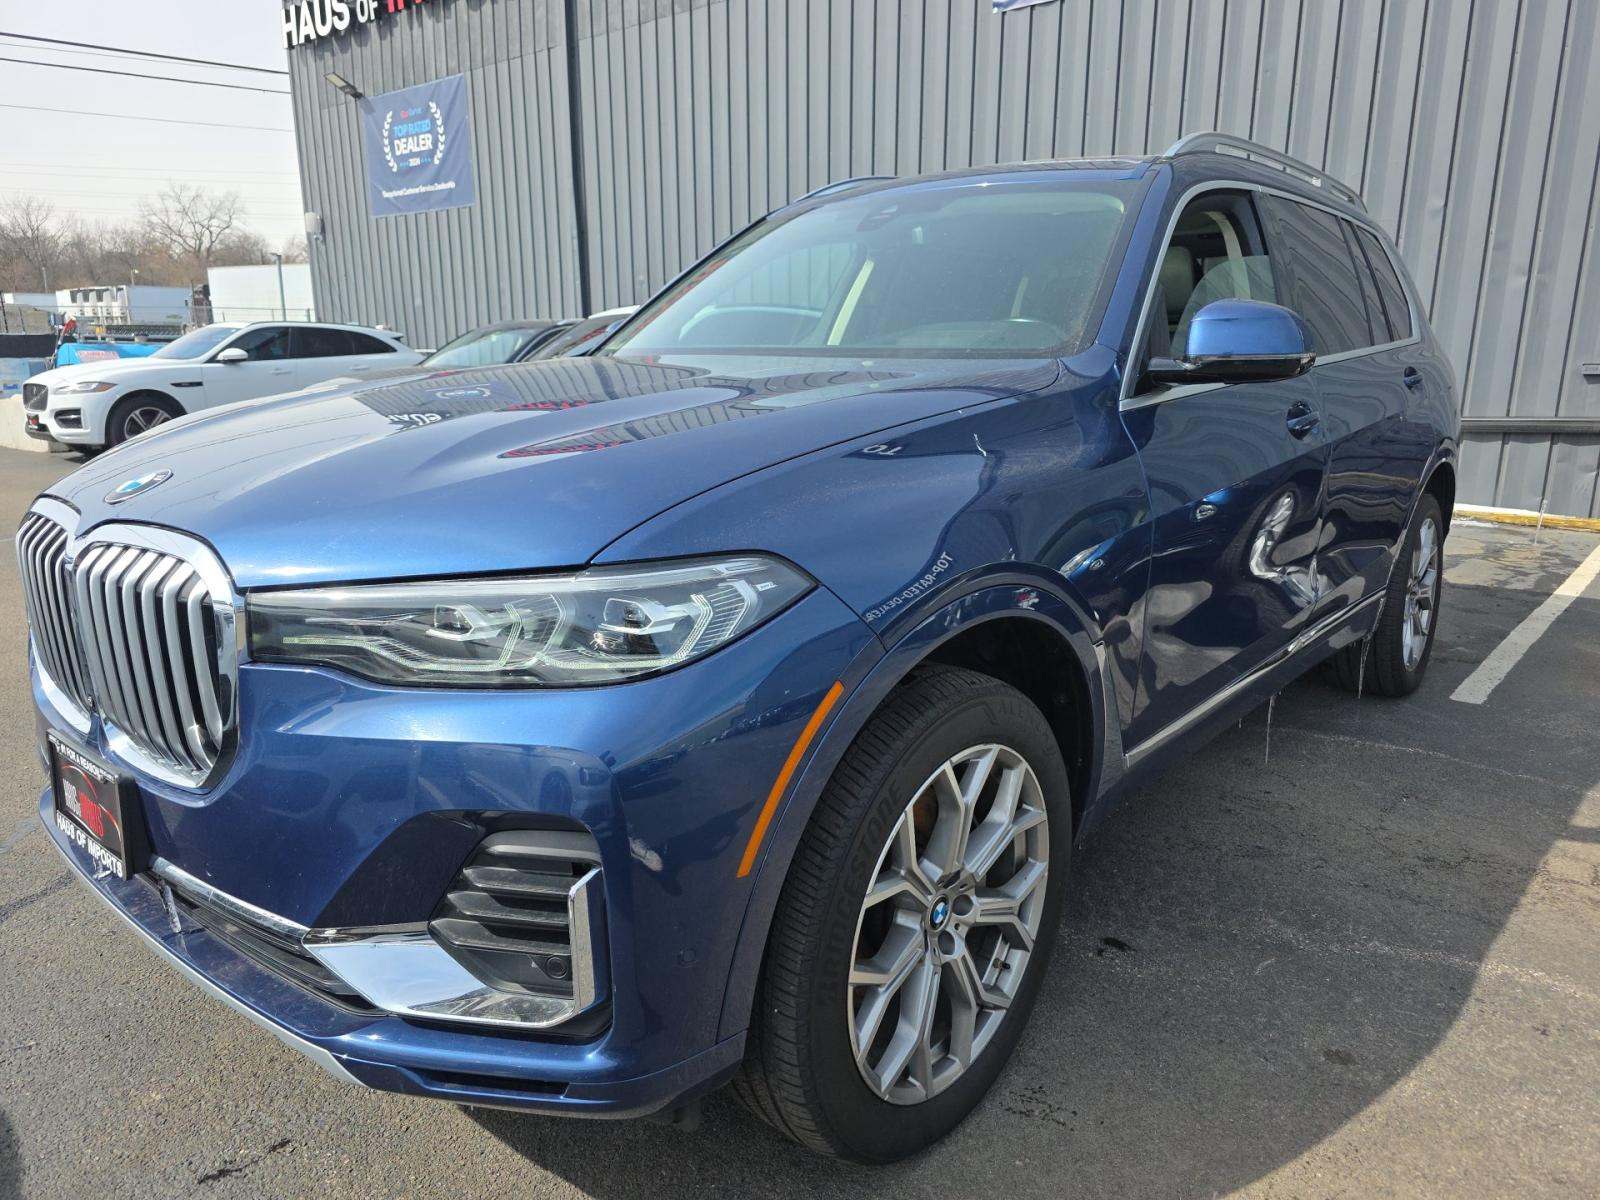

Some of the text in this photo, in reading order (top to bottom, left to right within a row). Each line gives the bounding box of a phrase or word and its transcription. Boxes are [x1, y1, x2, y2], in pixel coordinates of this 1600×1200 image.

[281, 0, 378, 49] HAUS OF
[393, 133, 433, 156] DEALER
[76, 829, 86, 848] OF
[88, 837, 122, 877] IMPORTS
